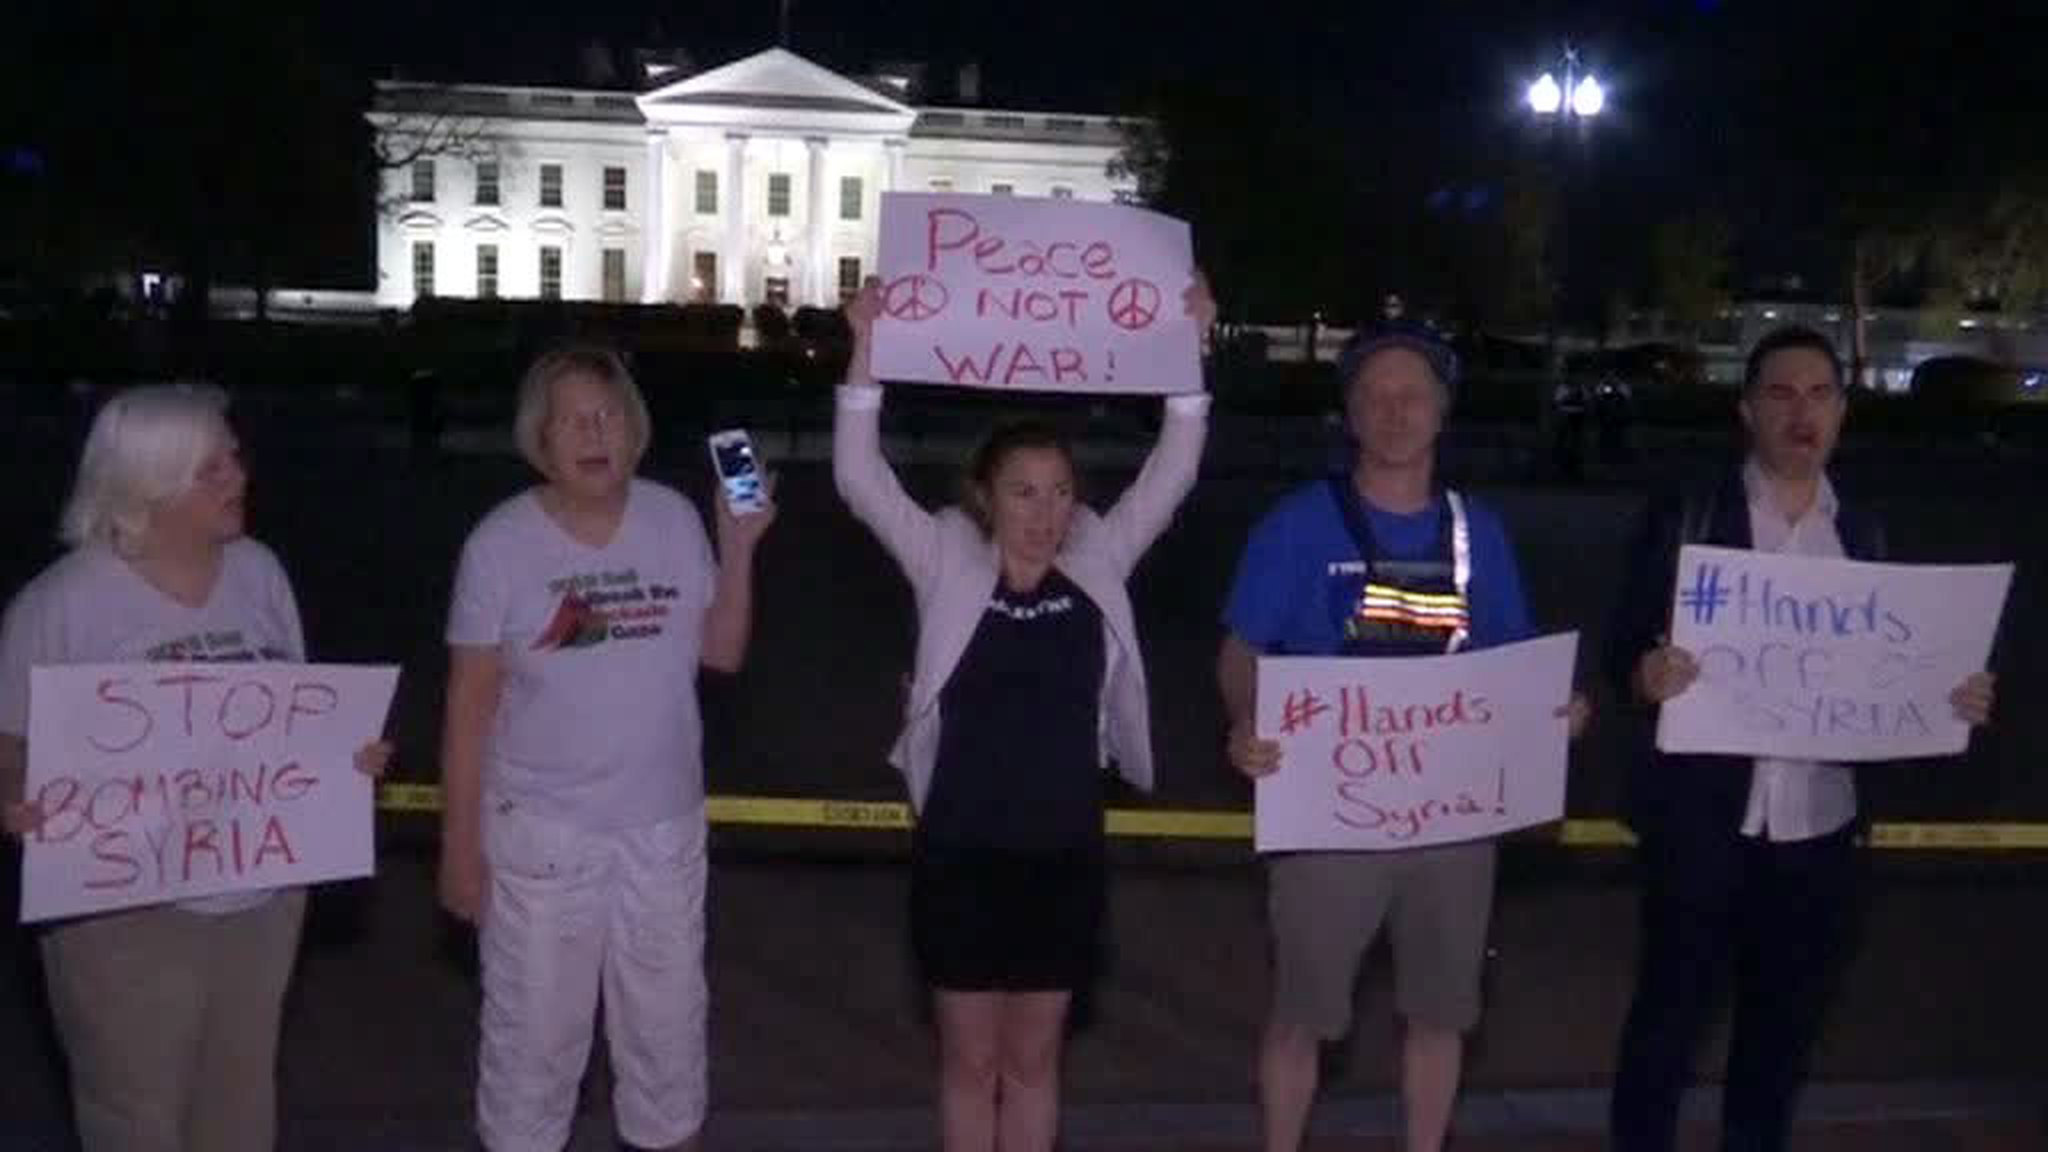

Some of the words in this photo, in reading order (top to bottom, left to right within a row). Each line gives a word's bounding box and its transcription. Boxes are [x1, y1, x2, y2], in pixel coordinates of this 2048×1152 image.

[928, 208, 1116, 278] Peace
[977, 287, 1088, 327] NOT
[87, 674, 338, 752] STOP
[35, 762, 320, 842] BOMBING
[84, 814, 296, 888] SYRIA
